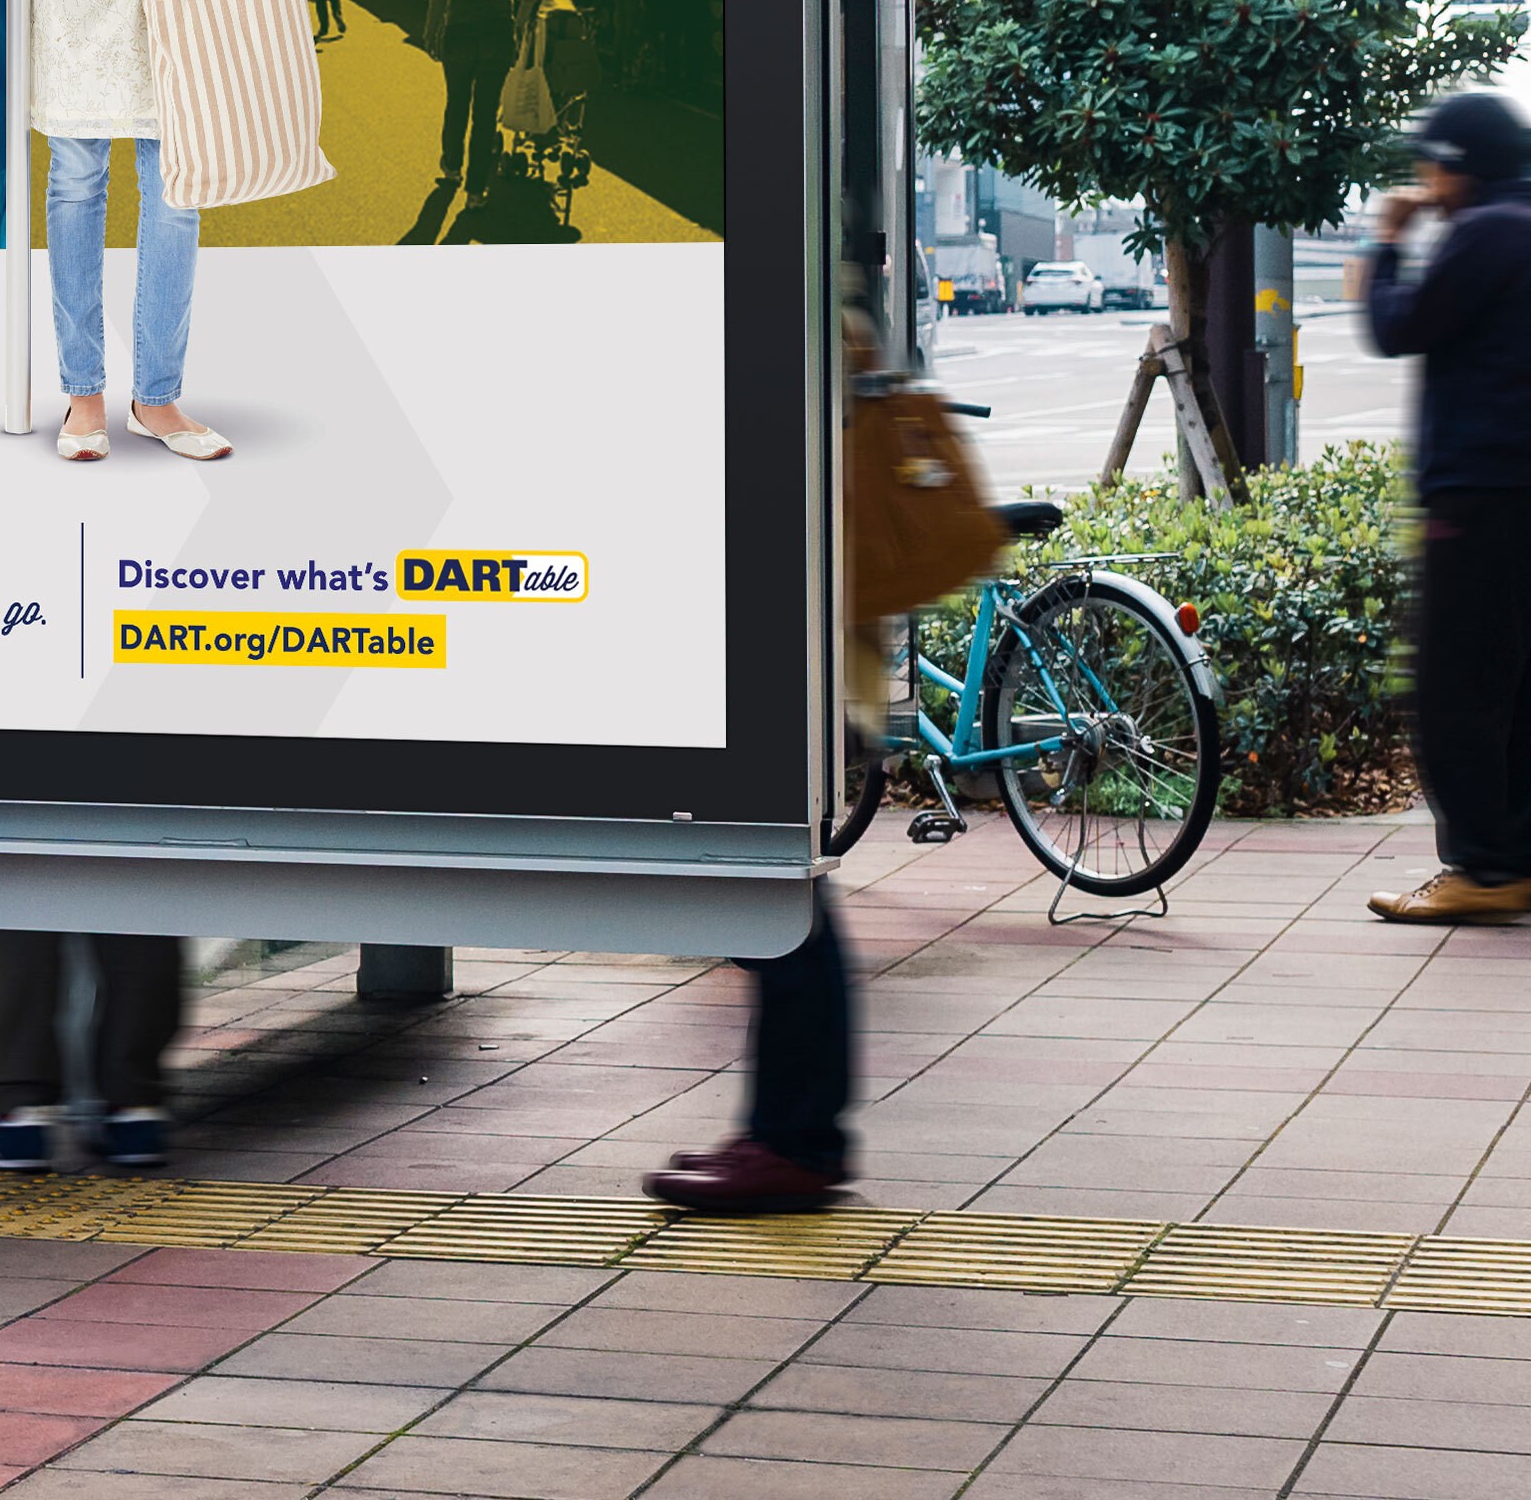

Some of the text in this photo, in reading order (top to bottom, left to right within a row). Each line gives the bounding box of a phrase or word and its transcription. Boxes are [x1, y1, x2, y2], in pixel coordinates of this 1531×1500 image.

[119, 559, 266, 590] Discover
[276, 559, 389, 592] what’s
[1, 601, 47, 636] go.
[120, 624, 435, 661] DART.org/DARTable
